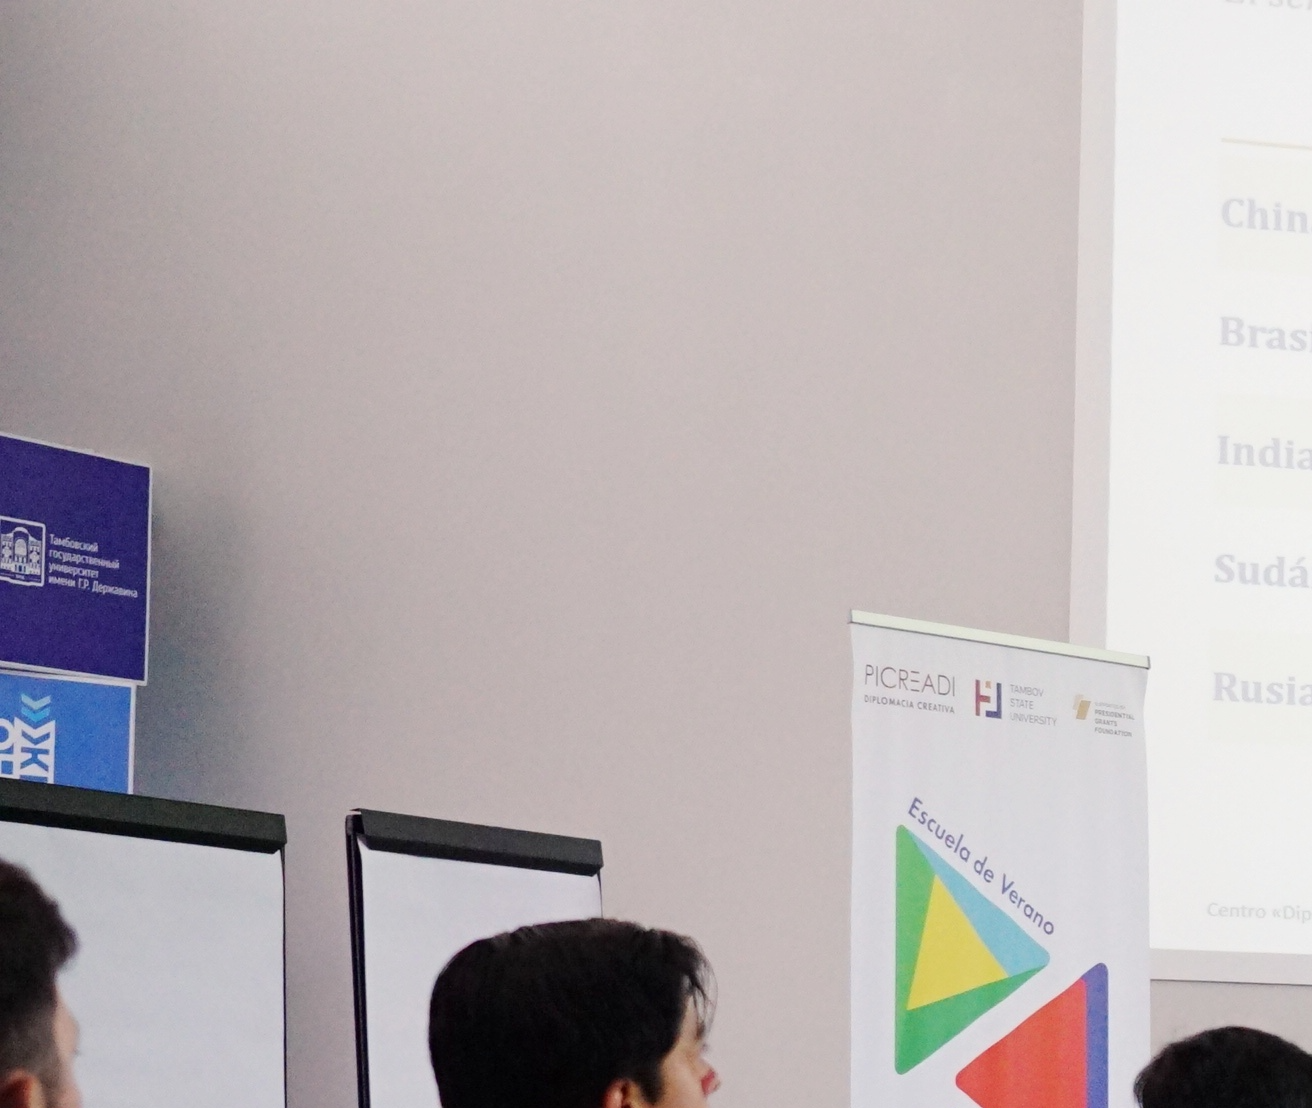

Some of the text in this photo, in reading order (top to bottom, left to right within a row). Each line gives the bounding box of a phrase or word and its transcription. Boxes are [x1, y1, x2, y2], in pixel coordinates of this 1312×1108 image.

[49, 533, 99, 553] Тамбовский
[48, 549, 120, 569] государственный
[48, 562, 100, 578] университет
[48, 576, 76, 587] имени
[92, 580, 138, 598] Державина
[864, 664, 956, 697] PICREADI
[1010, 684, 1045, 698] TAMBOV
[864, 694, 955, 714] DIPLOMACIA CREATIVA
[1010, 698, 1034, 710] STATE
[1010, 713, 1057, 727] UNIVERSITY
[1094, 709, 1135, 721] PRESIDENTIAL
[907, 797, 1054, 935] Escuela de Verano
[1205, 901, 1268, 920] Centro
